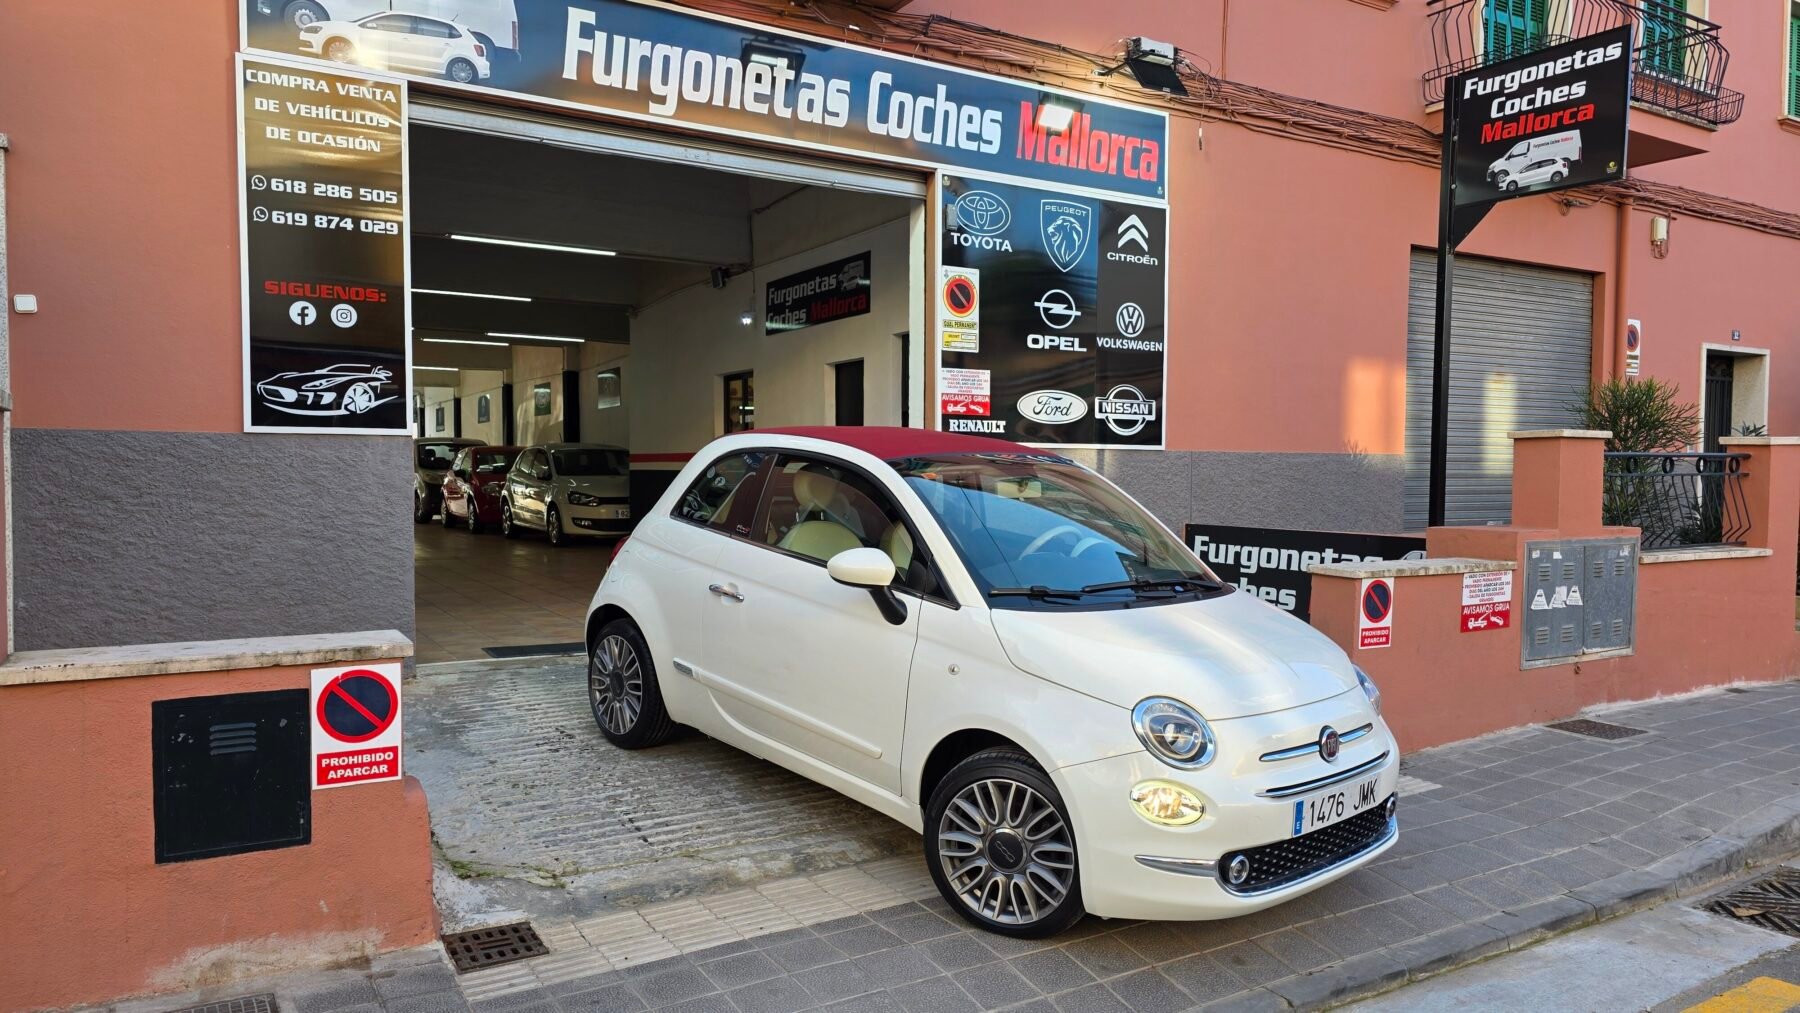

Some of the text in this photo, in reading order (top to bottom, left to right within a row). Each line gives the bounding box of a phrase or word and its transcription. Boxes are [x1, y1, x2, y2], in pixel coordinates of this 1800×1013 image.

[1463, 42, 1623, 100] Furgonetas
[246, 68, 396, 103] COMPRA VENTA
[562, 6, 1159, 182] Furgonetas Coches Mallorca
[1490, 80, 1587, 119] Coches
[255, 97, 390, 128] DE VEHÍCULOS
[1480, 103, 1595, 144] Mallorca
[266, 126, 381, 153] DE OCASIÓN
[271, 178, 398, 204] 618 286 505
[271, 210, 399, 235] 619 874 029
[1044, 204, 1088, 218] PEUGEOT
[951, 232, 1013, 252] TOYOTA
[264, 280, 387, 302] SIGUENOS:
[768, 274, 837, 306] Furgonetas
[810, 293, 867, 321] Mallorca
[1027, 333, 1088, 352] OPEL
[1096, 336, 1163, 352] VOLKSWAGEN
[942, 394, 972, 402] AVISAMOS
[1032, 395, 1073, 417] Ford
[1102, 402, 1149, 415] NISSAN
[949, 419, 1006, 433] RENAULT
[1193, 535, 1384, 574] Furgonet
[1463, 604, 1493, 615] AVISAMOS
[1362, 629, 1389, 637] PROHIBIDO
[321, 751, 394, 767] PROHIBIDO
[328, 764, 388, 780] APARCAR
[1310, 779, 1378, 827] 1476 JMK
